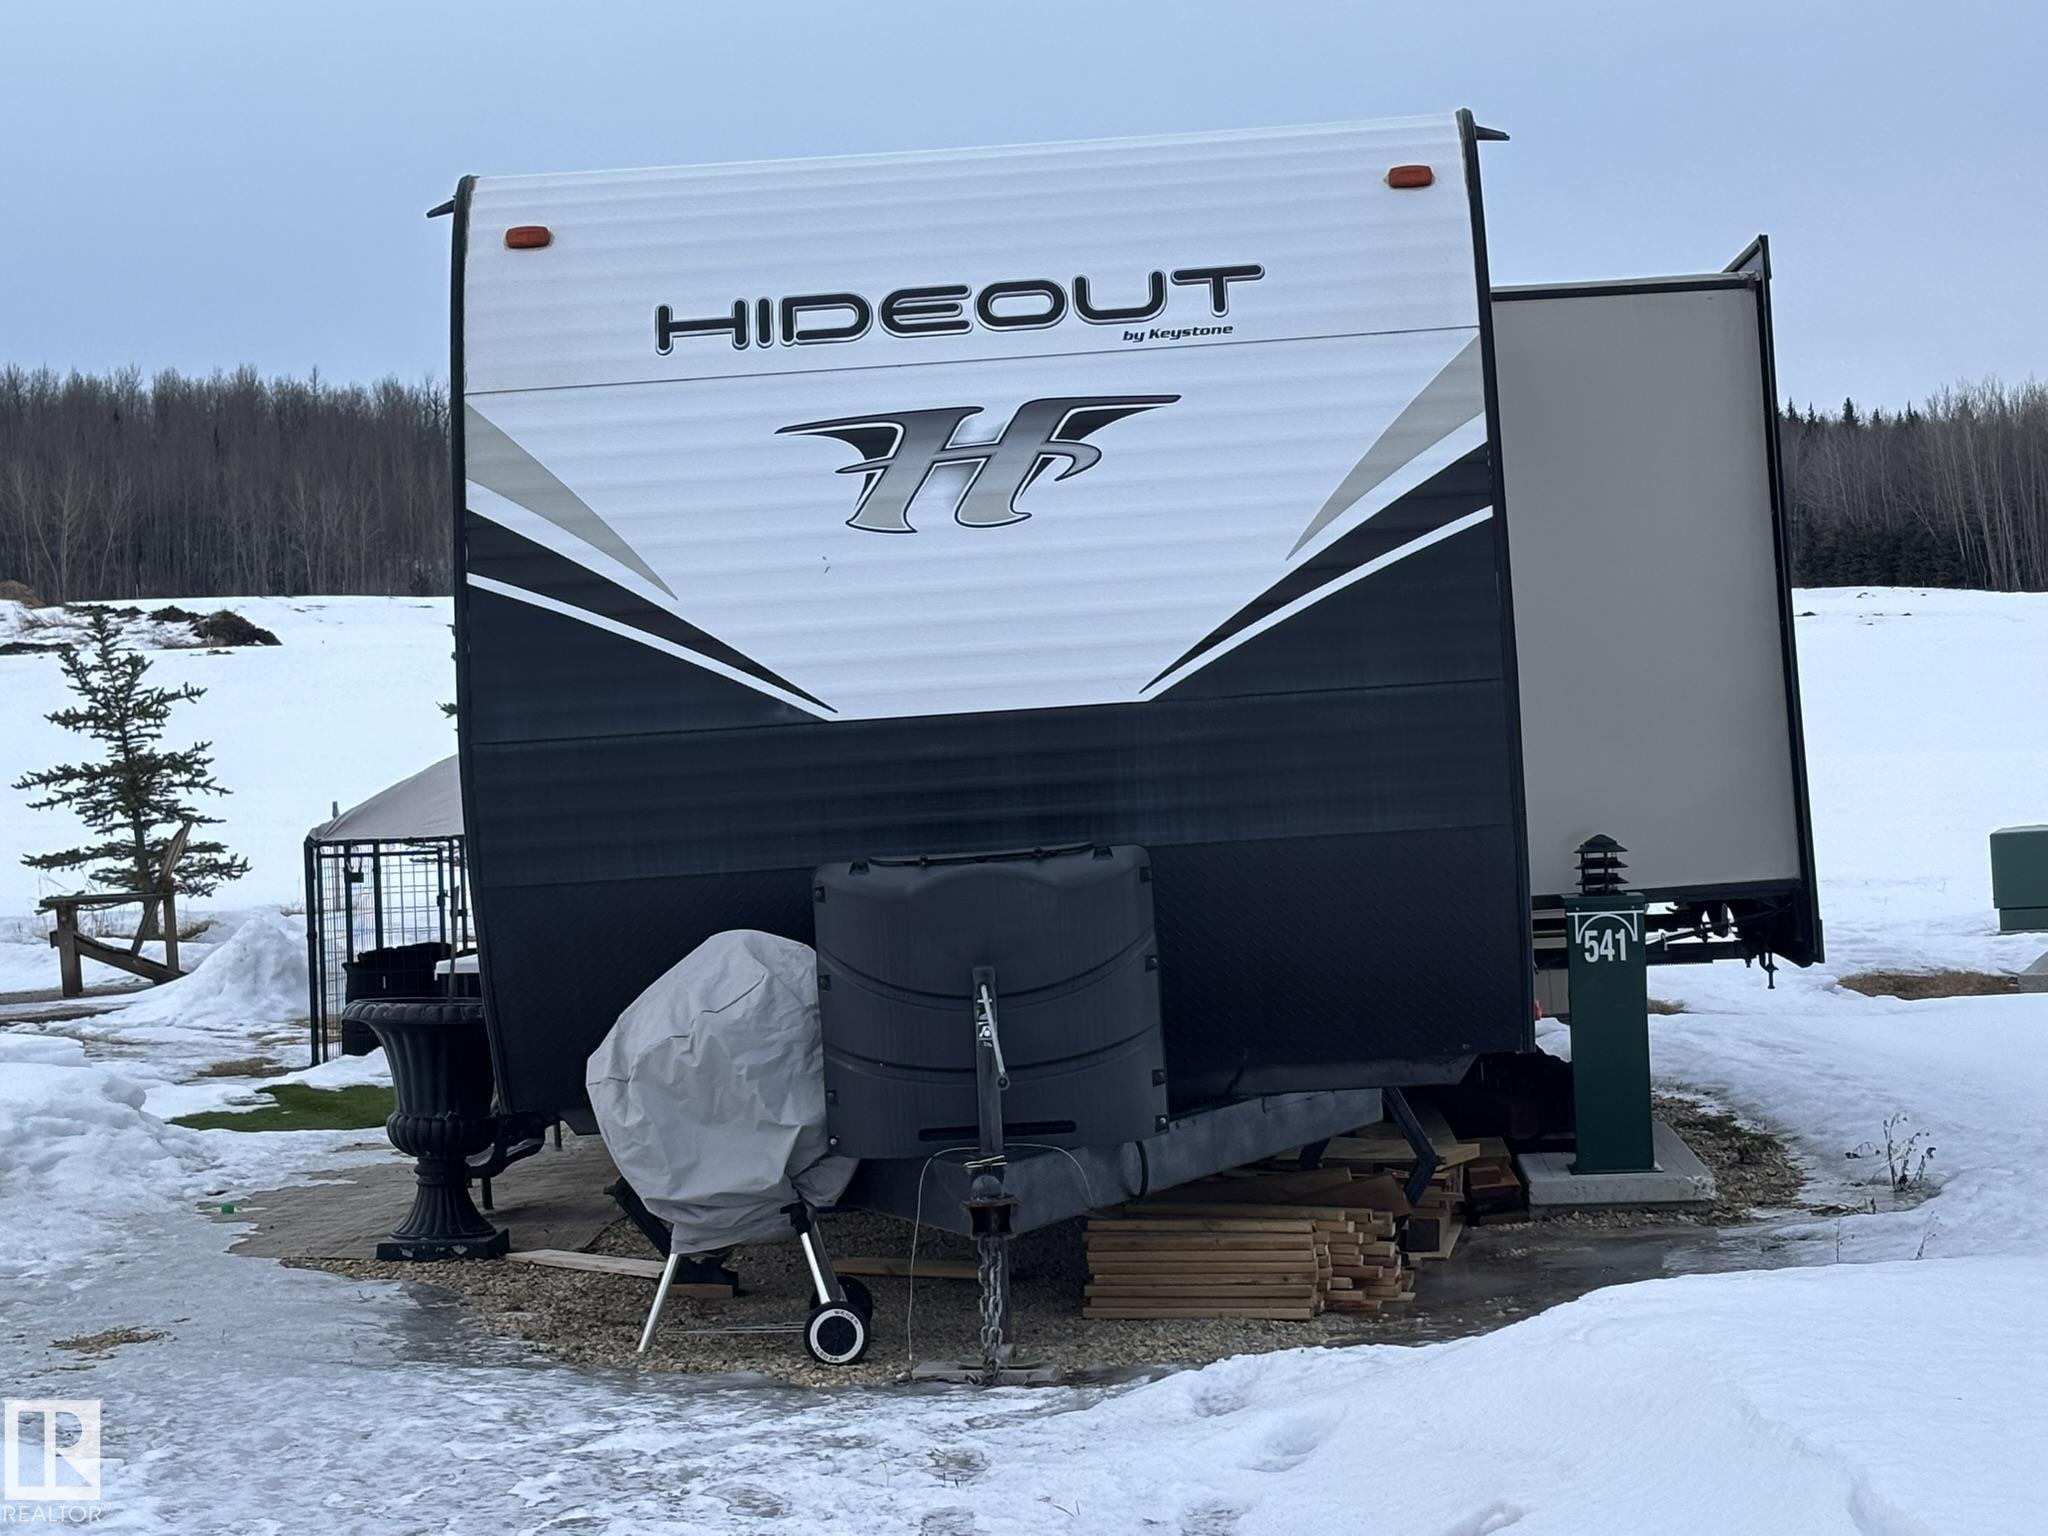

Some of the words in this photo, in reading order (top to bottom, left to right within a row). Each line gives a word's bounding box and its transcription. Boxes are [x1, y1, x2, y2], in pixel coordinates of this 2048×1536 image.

[654, 264, 1265, 356] HIDEOUT
[1122, 330, 1146, 343] by
[1148, 325, 1234, 341] Keystone
[1584, 928, 1627, 963] 541
